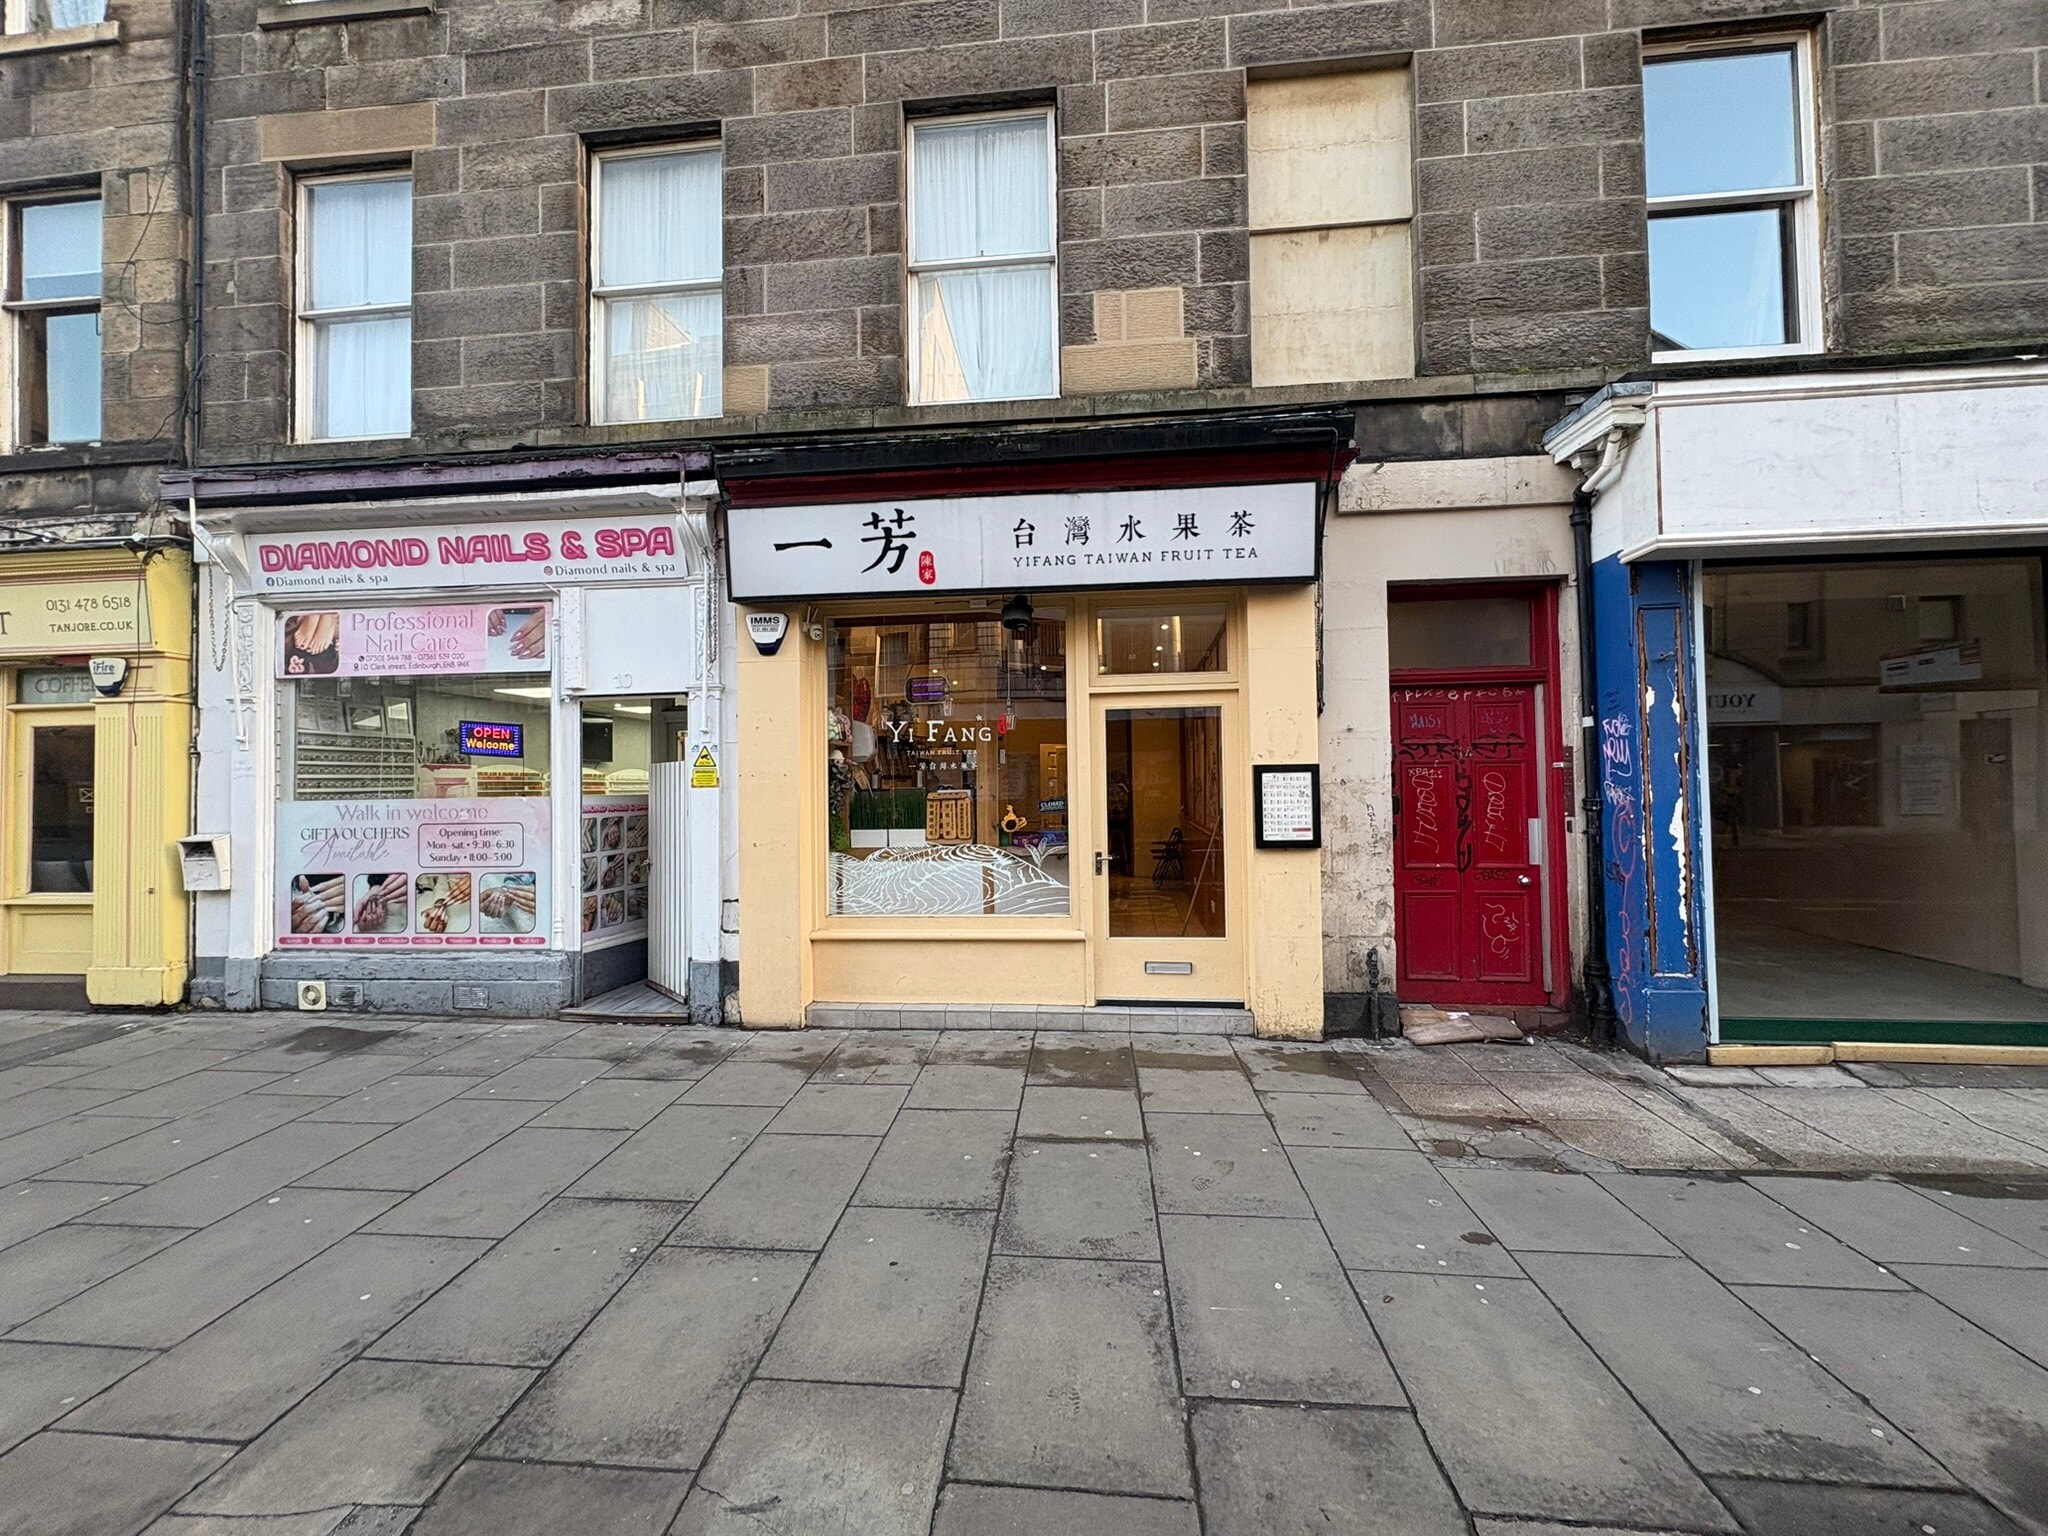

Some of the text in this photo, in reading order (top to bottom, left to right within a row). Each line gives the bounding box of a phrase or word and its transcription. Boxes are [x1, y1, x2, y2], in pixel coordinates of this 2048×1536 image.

[1012, 510, 1256, 549] 台灣水果茶
[773, 508, 917, 574] 一芳
[259, 526, 675, 572] DIAMOND NAILS & SPA
[1013, 547, 1258, 567] YIFANG TAIWAN FRUIT TEA
[555, 563, 676, 576] Diamond nails & spa
[275, 574, 389, 587] Diamond nails & spa
[45, 595, 132, 613] 0131 478 6518
[49, 621, 133, 633] TANJORE.CO.UK
[351, 609, 474, 631] Professional
[750, 616, 781, 625] IMMS
[365, 632, 459, 653] Nail Care
[93, 660, 115, 672] iFire
[34, 676, 96, 694] COFFE
[473, 727, 511, 740] OPEN
[465, 738, 515, 751] Welcome
[1040, 800, 1065, 808] CLOSED
[336, 804, 381, 820] Walk
[386, 804, 401, 820] in
[300, 826, 410, 841] GIFT VOUCHERS
[438, 828, 478, 839] Opening
[429, 853, 461, 864] Sunday
